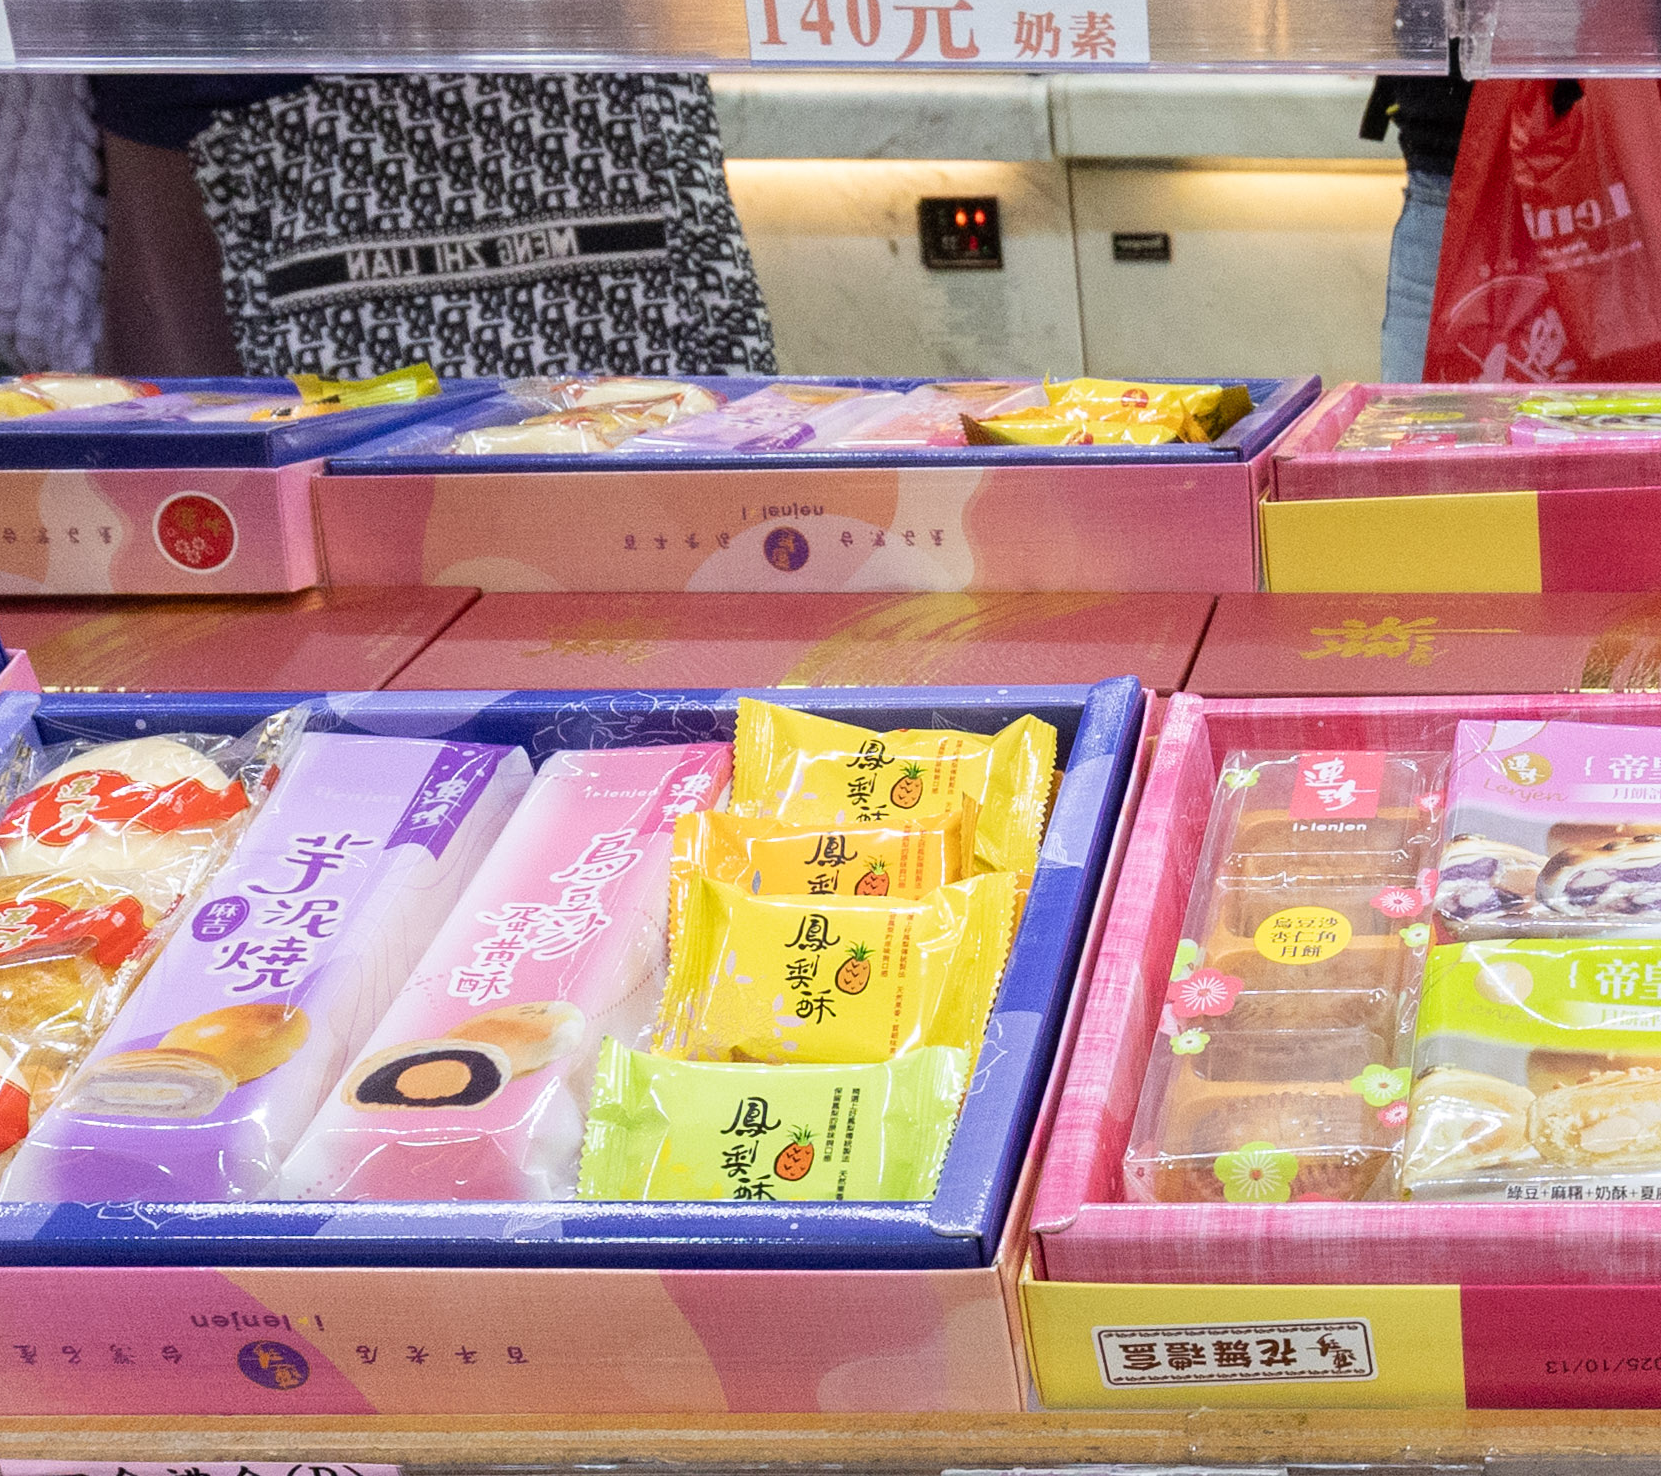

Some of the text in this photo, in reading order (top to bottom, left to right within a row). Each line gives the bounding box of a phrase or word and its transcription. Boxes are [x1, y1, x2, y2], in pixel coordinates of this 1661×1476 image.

[1012, 11, 1118, 60] 奶素
[203, 903, 242, 937] 麻吉
[452, 905, 544, 1003] 蛋黃酥
[786, 913, 841, 1025] 鳳梨酥
[1279, 944, 1324, 960] 月餅
[189, 1312, 292, 1334] lenjen
[1117, 1337, 1298, 1372] 花舞禮盒
